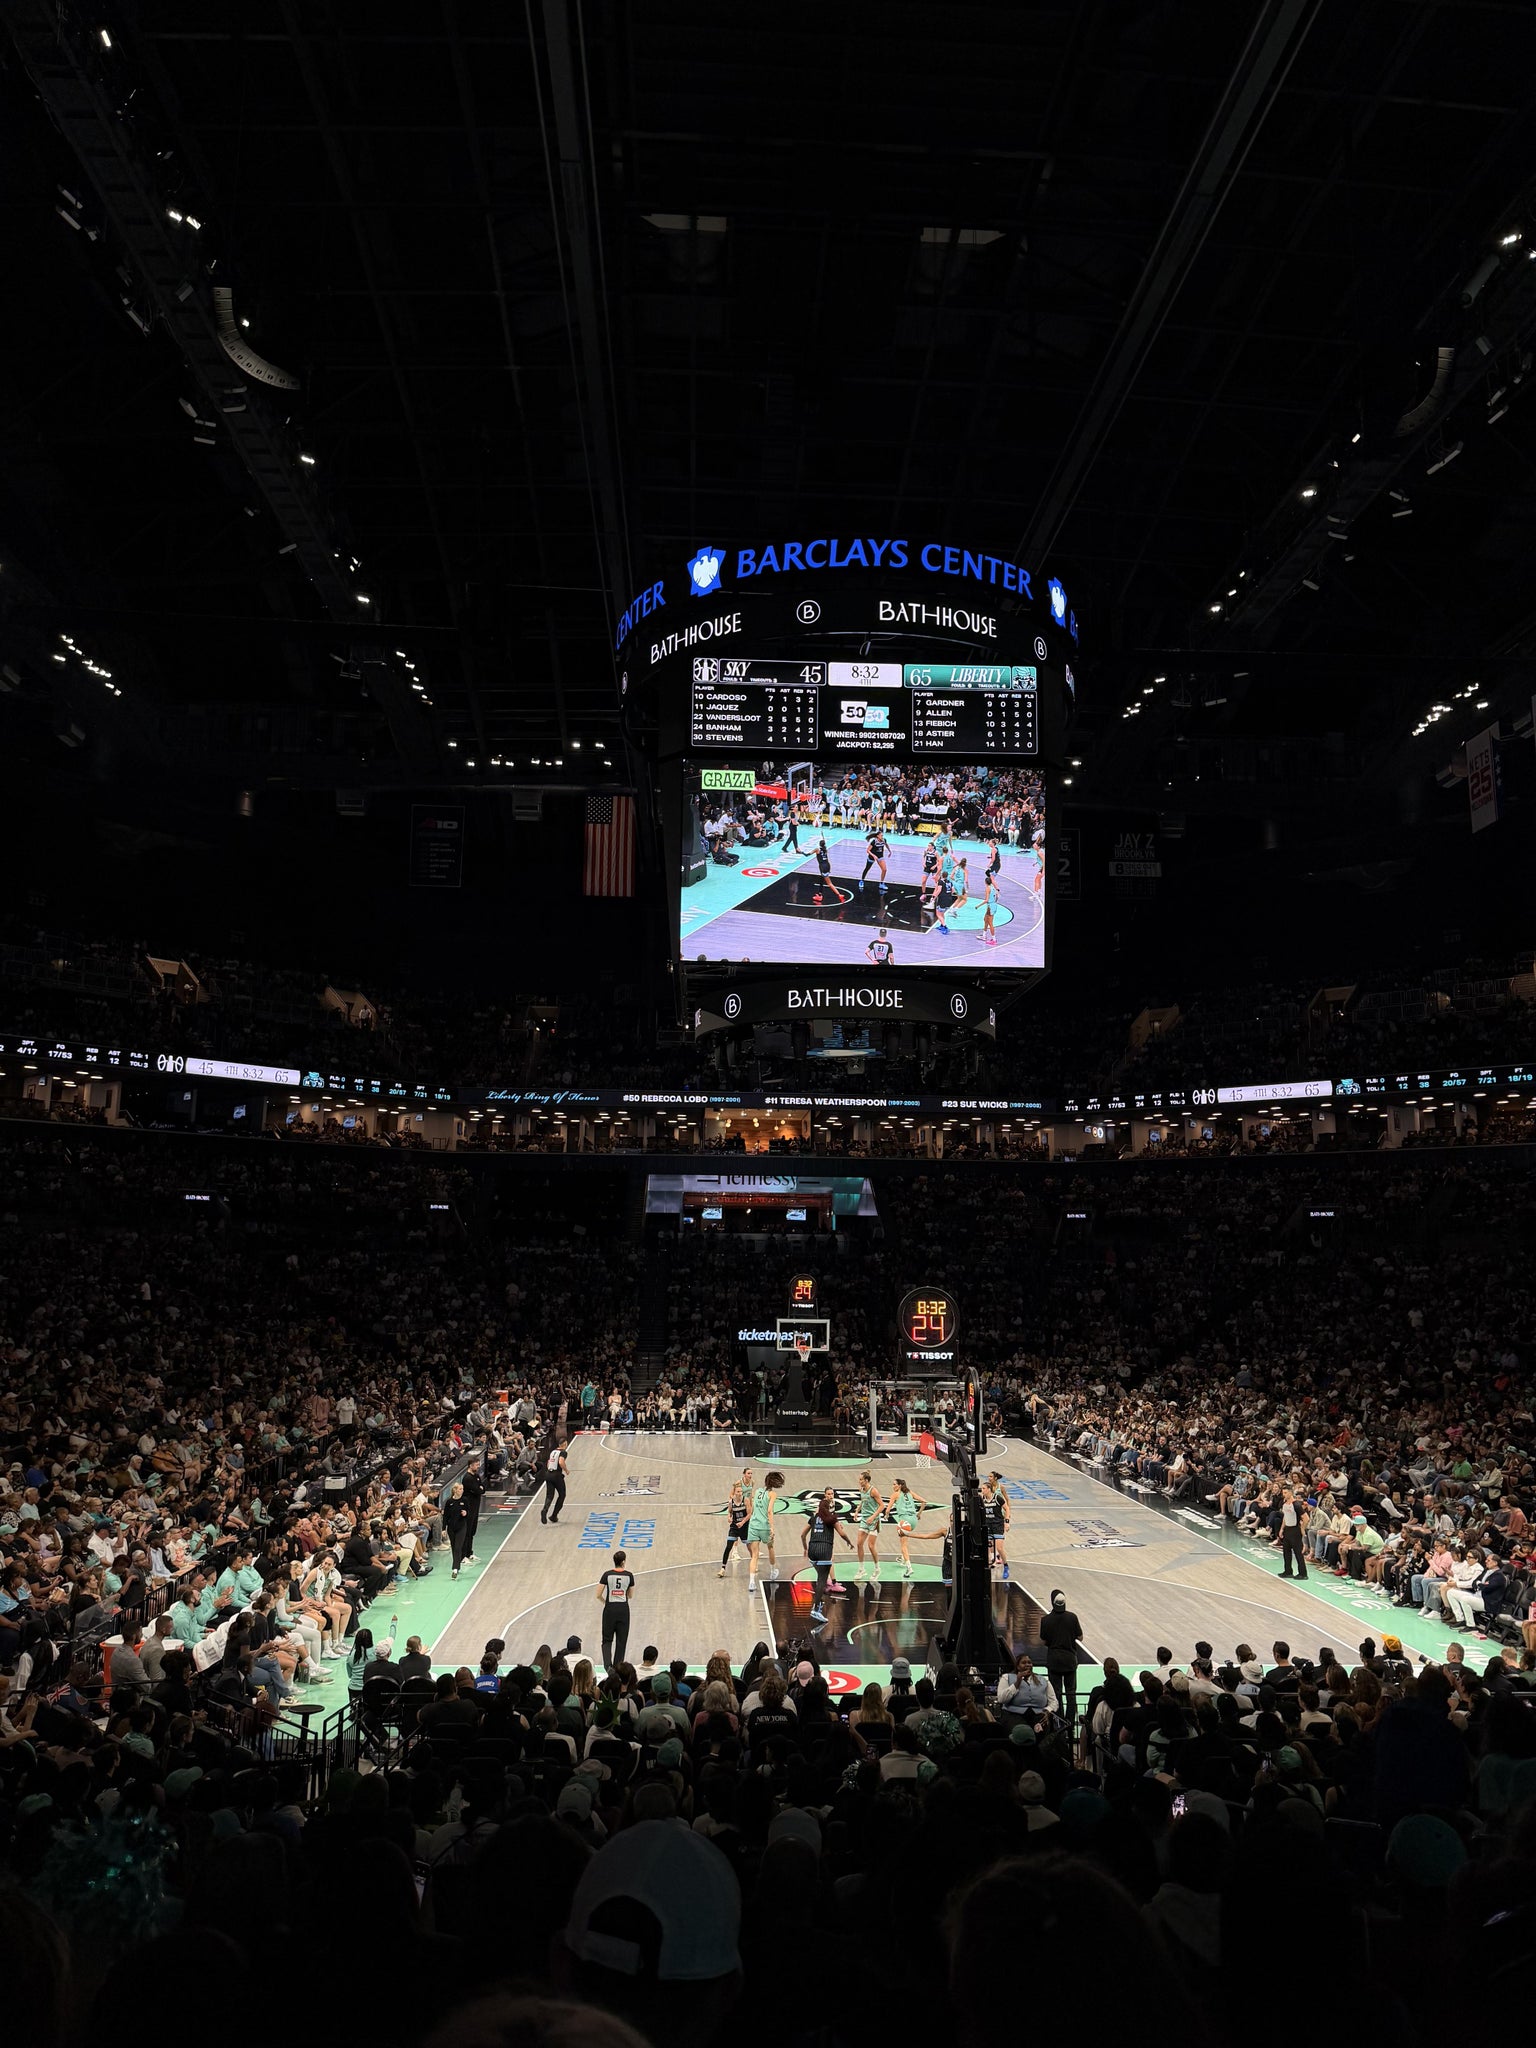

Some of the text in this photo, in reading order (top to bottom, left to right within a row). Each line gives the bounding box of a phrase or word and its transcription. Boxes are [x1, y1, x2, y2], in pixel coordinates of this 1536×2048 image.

[736, 539, 1033, 600] BARCLAYS CENTER
[615, 580, 666, 650] CENTER
[803, 604, 814, 619] B
[879, 601, 997, 638] BATHHOUSE
[651, 613, 742, 664] BATHHOUSE
[725, 662, 821, 683] SKY 45
[851, 666, 879, 679] 8:32
[910, 668, 1006, 686] 65 LIBERTY
[706, 714, 761, 722] VANDERSLOOT
[846, 706, 865, 718] 50
[866, 709, 885, 722] 50
[706, 734, 743, 742] STEVENS
[824, 731, 858, 739] WINNER:
[1469, 750, 1490, 771] NETS
[703, 773, 754, 789] GRAZA
[1115, 832, 1141, 848] JAY
[728, 989, 963, 1014] B BATHHOUSE B
[17, 1047, 38, 1055] 4/17
[48, 1050, 73, 1059] 17/53
[198, 1062, 213, 1075] 45
[242, 1067, 263, 1079] 8:32
[274, 1070, 289, 1083] 65
[1508, 1074, 1533, 1082] 18/19
[485, 1090, 600, 1104] Liberty Ring Of Honor
[641, 1095, 682, 1103] REBECCA
[684, 1095, 708, 1103] LOBO
[1229, 1084, 1320, 1101] 45 8:32 65
[765, 1097, 887, 1107] #11 TERESA WEATHERSPOON
[978, 1101, 1008, 1109] WICKS
[795, 1287, 811, 1300] 24
[918, 1301, 946, 1315] 8:32
[912, 1316, 944, 1341] 24
[919, 1352, 954, 1360] TISSOT
[578, 1512, 620, 1548] BARCLAYS
[619, 1519, 657, 1549] CENTER
[616, 1578, 622, 1589] 5
